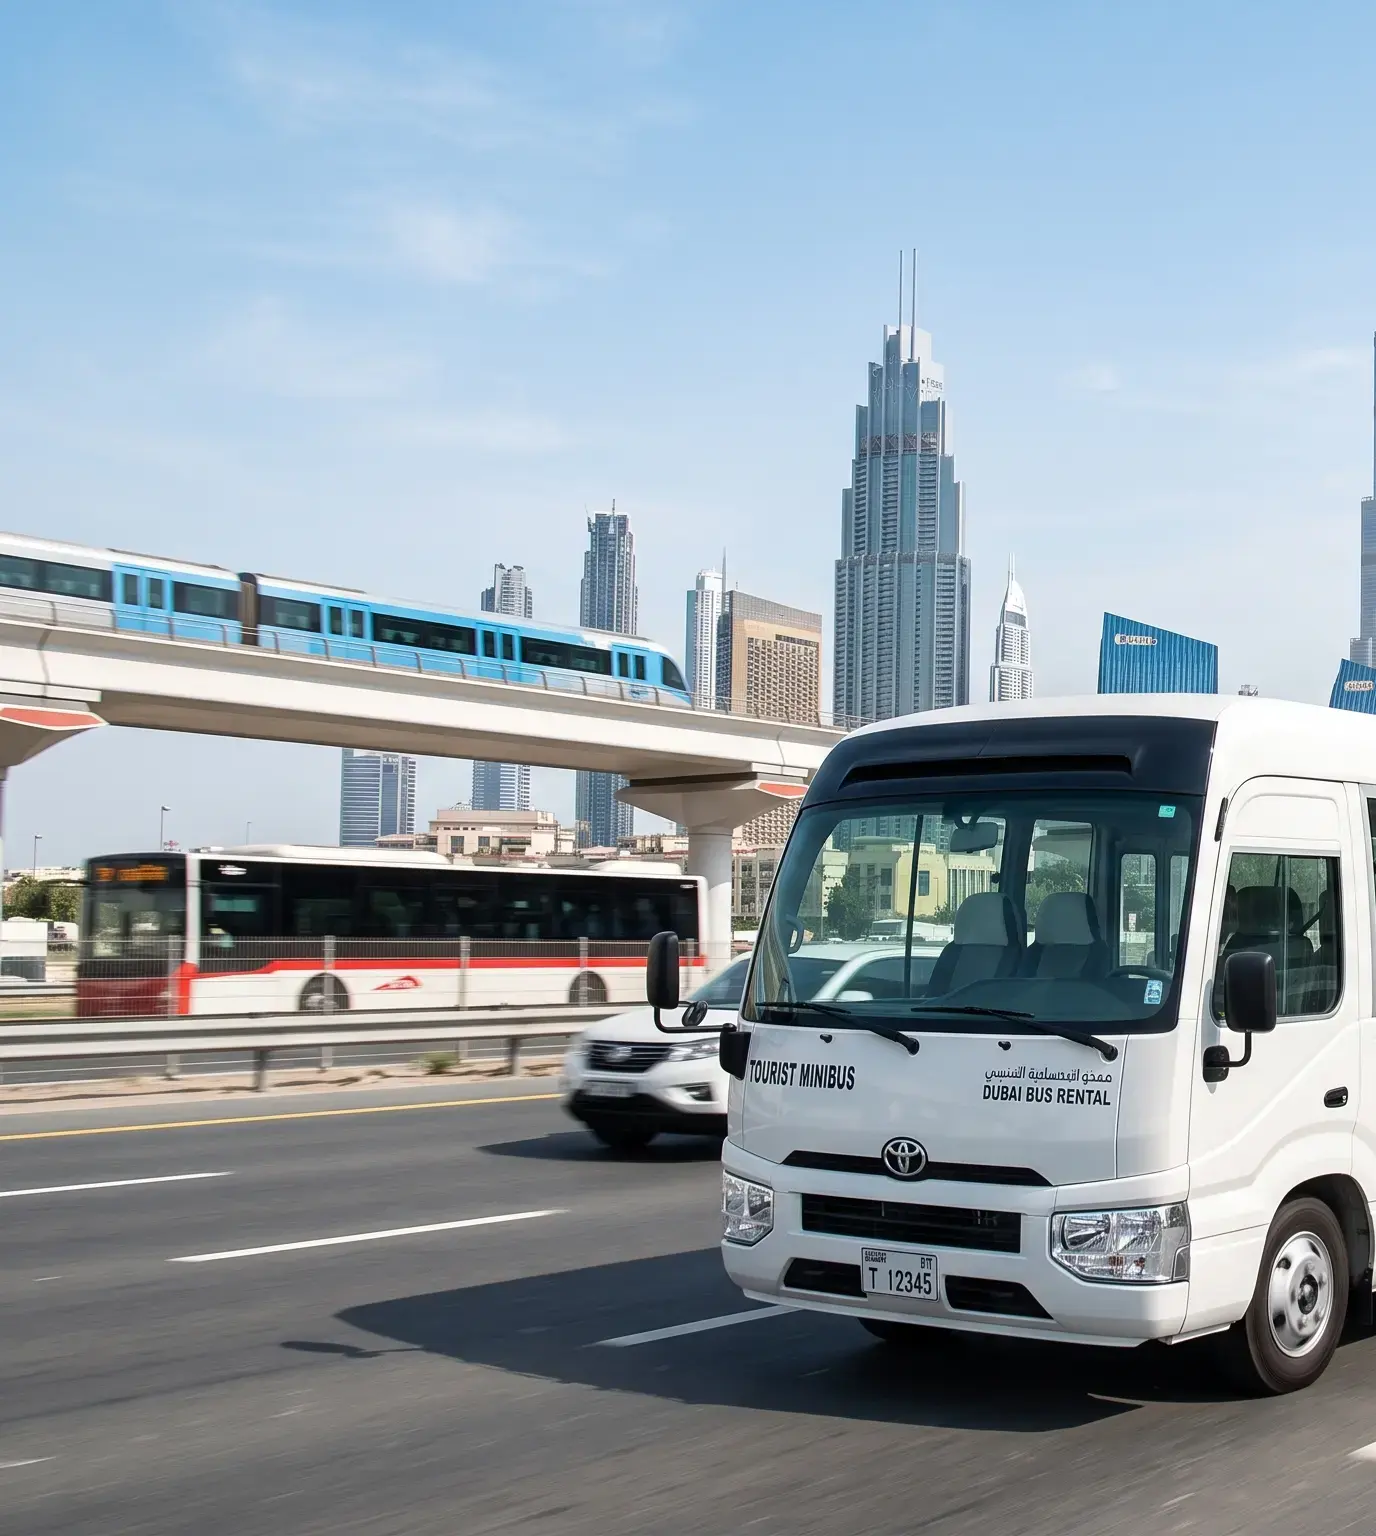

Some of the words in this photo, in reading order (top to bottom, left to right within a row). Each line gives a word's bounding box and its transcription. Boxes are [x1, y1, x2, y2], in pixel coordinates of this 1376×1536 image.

[749, 1059, 797, 1086] TOURIST
[799, 1063, 856, 1091] MINIBUS
[982, 1084, 1022, 1102] DUBAI
[1025, 1086, 1053, 1103] BUS
[1056, 1088, 1112, 1106] RENTAL
[868, 1266, 878, 1290] T
[888, 1269, 932, 1295] 12345
